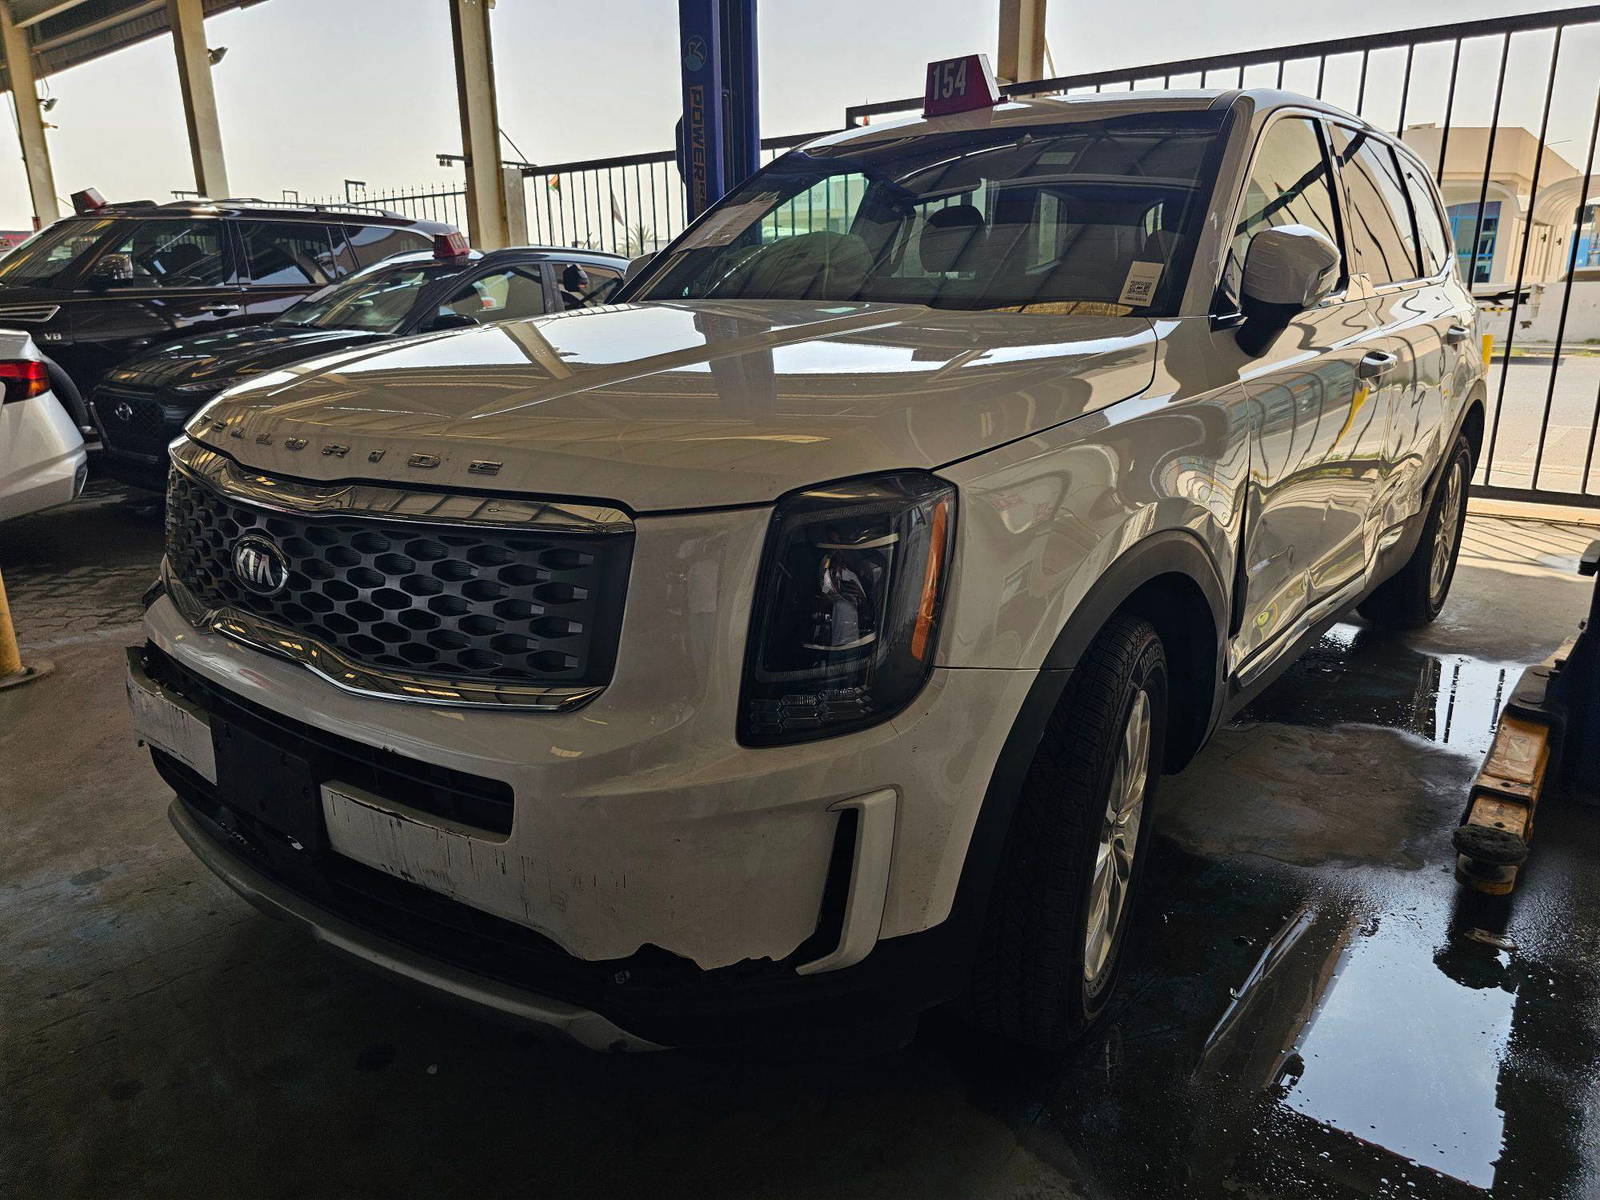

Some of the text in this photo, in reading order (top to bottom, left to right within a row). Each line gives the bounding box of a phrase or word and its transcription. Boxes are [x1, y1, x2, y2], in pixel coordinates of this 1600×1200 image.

[933, 60, 967, 100] 154
[44, 333, 62, 341] V8
[199, 415, 503, 476] TELLURIDE
[236, 547, 275, 587] KIA
